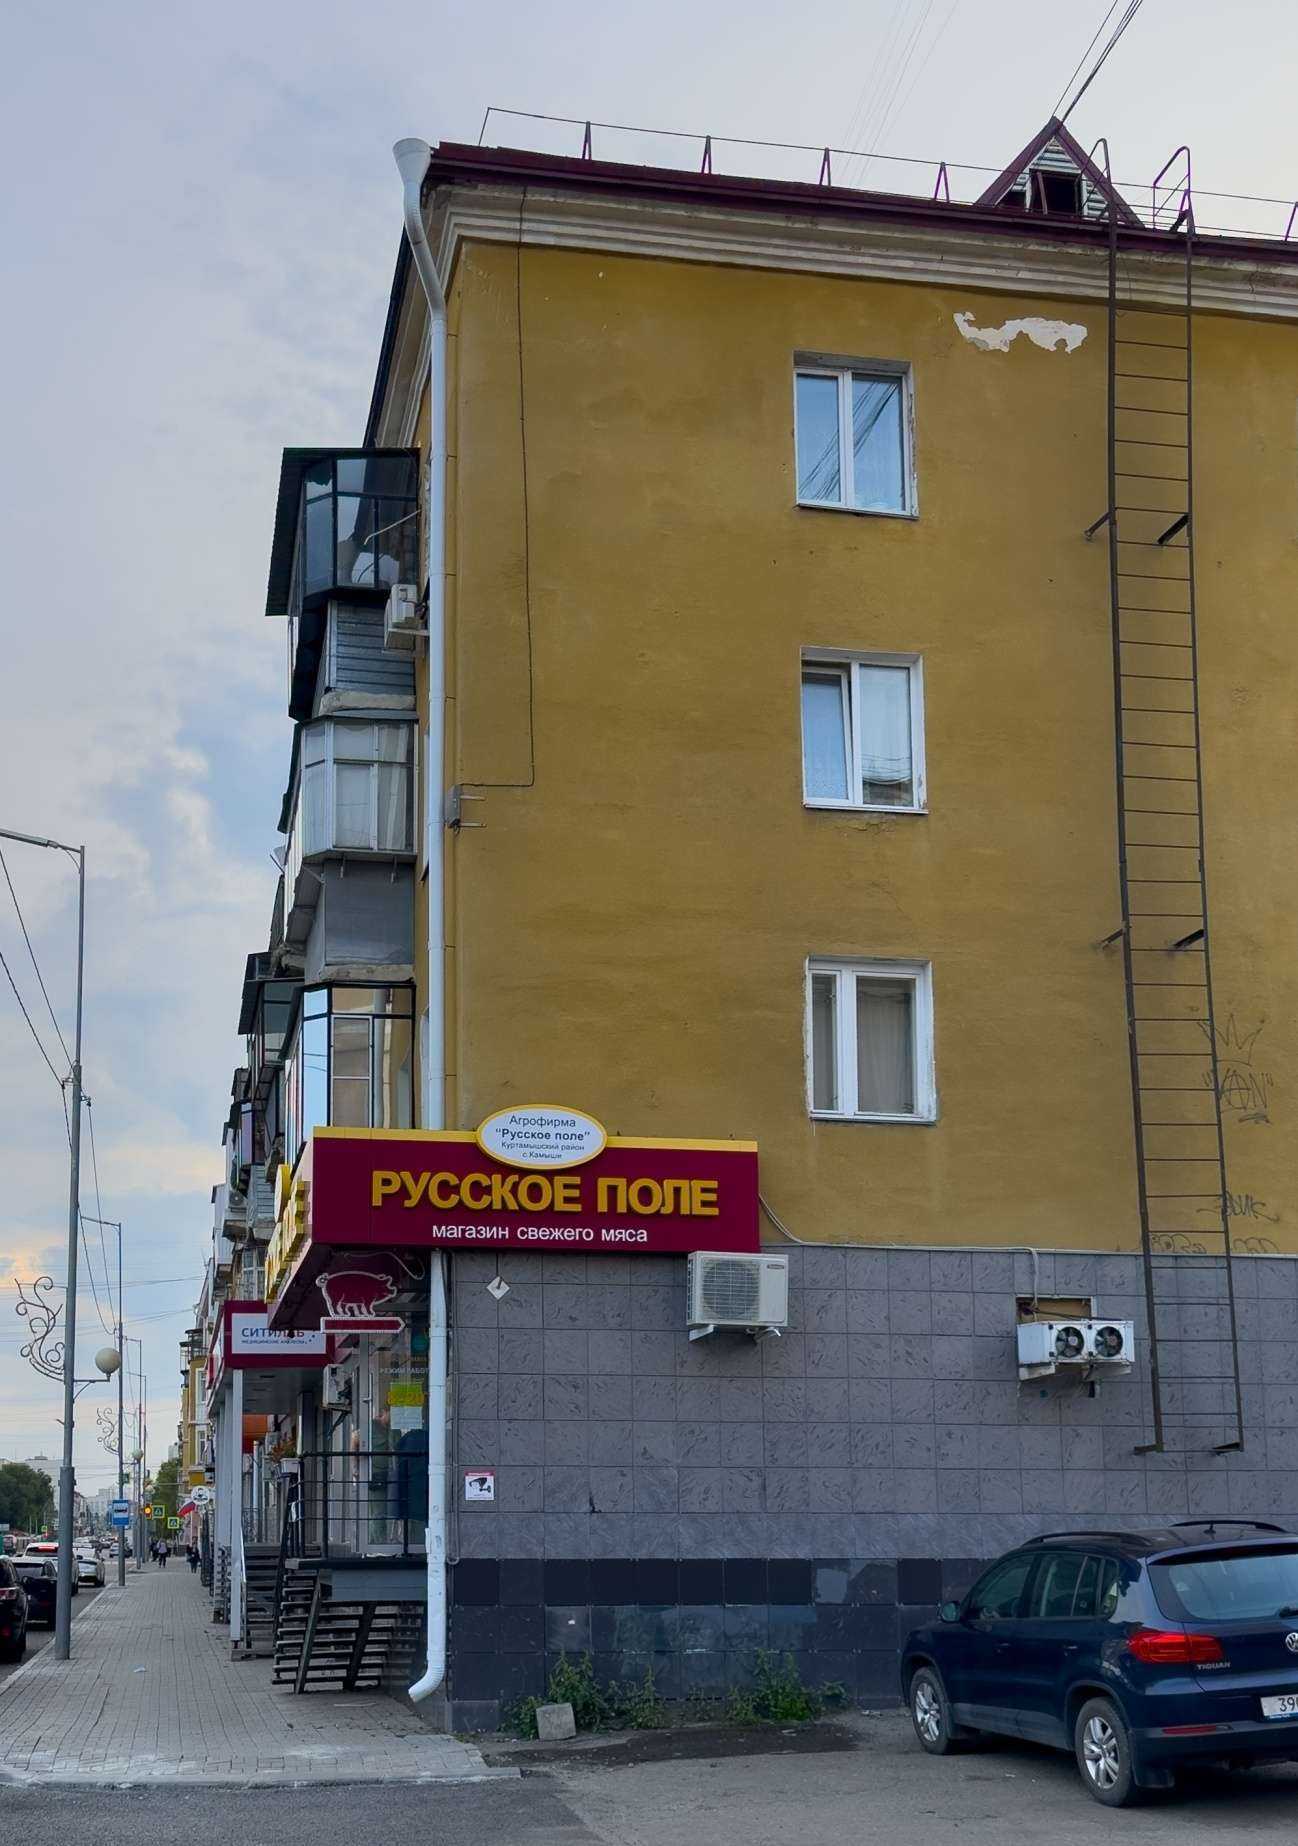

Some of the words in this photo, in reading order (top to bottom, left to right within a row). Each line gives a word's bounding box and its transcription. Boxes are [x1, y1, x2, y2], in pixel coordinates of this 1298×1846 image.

[509, 1115, 577, 1129] Агрофирма
[501, 1141, 559, 1150] Куртамышский
[561, 1143, 584, 1151] район
[371, 1170, 583, 1213] РУССКОЕ
[596, 1177, 720, 1216] ПОЛЕ
[432, 1223, 510, 1240] магазин
[516, 1227, 595, 1242] свежего
[600, 1227, 649, 1243] мяса
[1197, 1662, 1232, 1670] TIGUAN
[1278, 1696, 1298, 1713] 39
